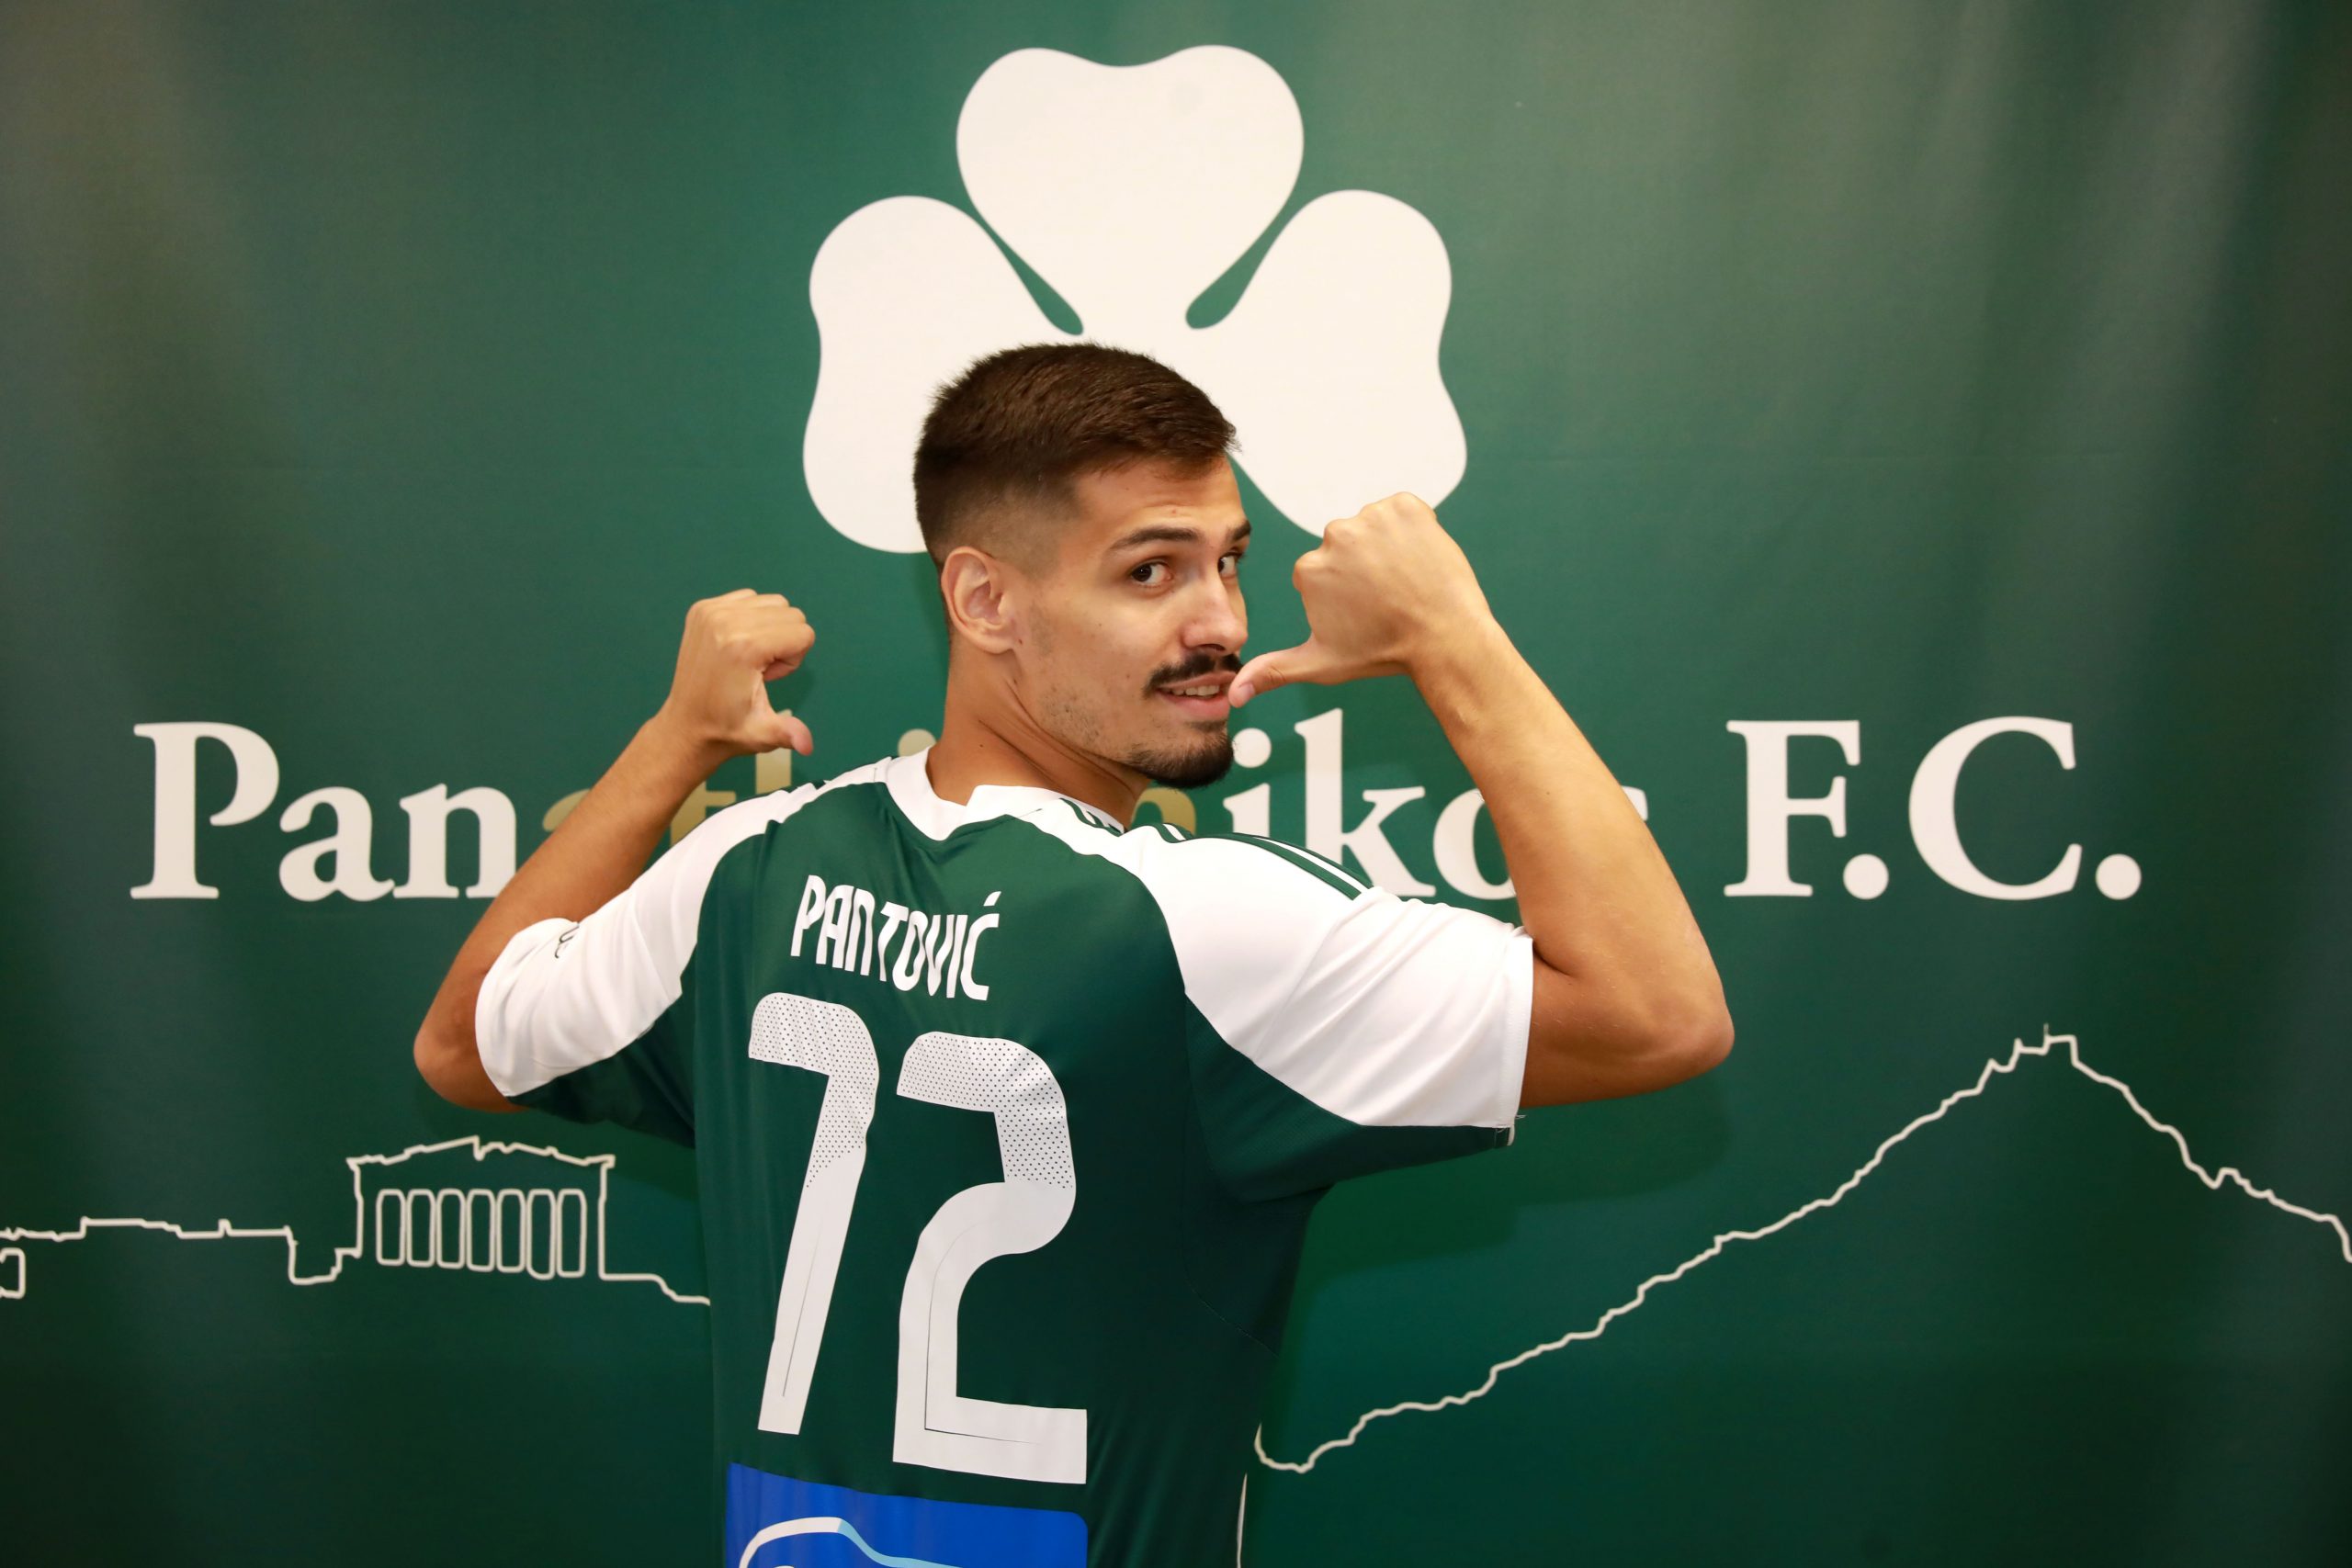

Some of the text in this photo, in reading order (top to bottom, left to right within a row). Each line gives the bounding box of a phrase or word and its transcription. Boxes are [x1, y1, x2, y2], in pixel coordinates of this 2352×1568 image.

[1724, 716, 2142, 901] F.C.
[790, 874, 1001, 1001] PANTOVIĆ
[749, 991, 1088, 1484] 72
